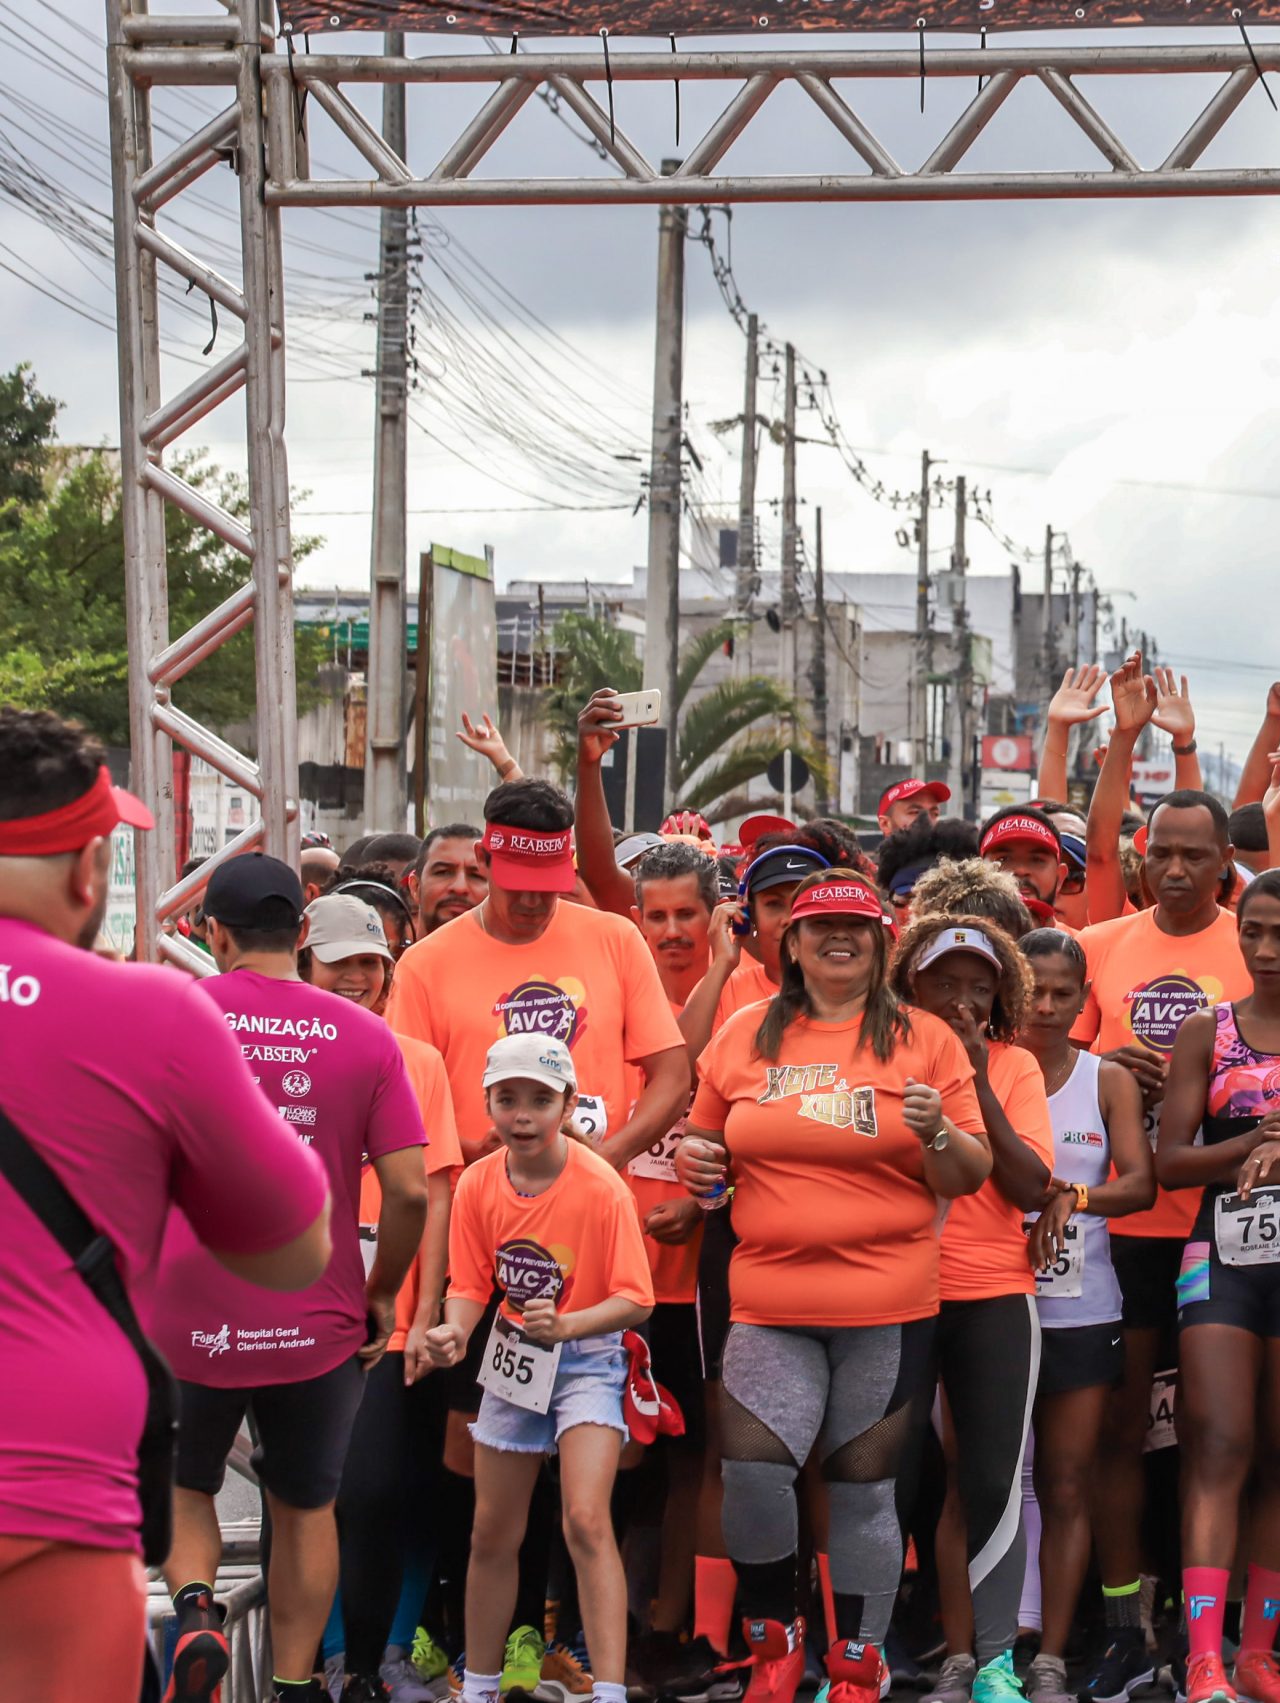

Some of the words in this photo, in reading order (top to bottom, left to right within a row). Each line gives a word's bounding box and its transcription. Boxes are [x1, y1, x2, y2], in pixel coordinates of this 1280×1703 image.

[510, 835, 565, 852] REABSERV
[812, 886, 867, 901] REABSERV
[1169, 990, 1207, 1001] PREVENÇÃO
[237, 1328, 274, 1340] Hospital
[275, 1326, 300, 1338] Geral
[236, 1340, 277, 1351] Cleriston
[278, 1337, 316, 1349] Andrade
[492, 1341, 535, 1385] 855
